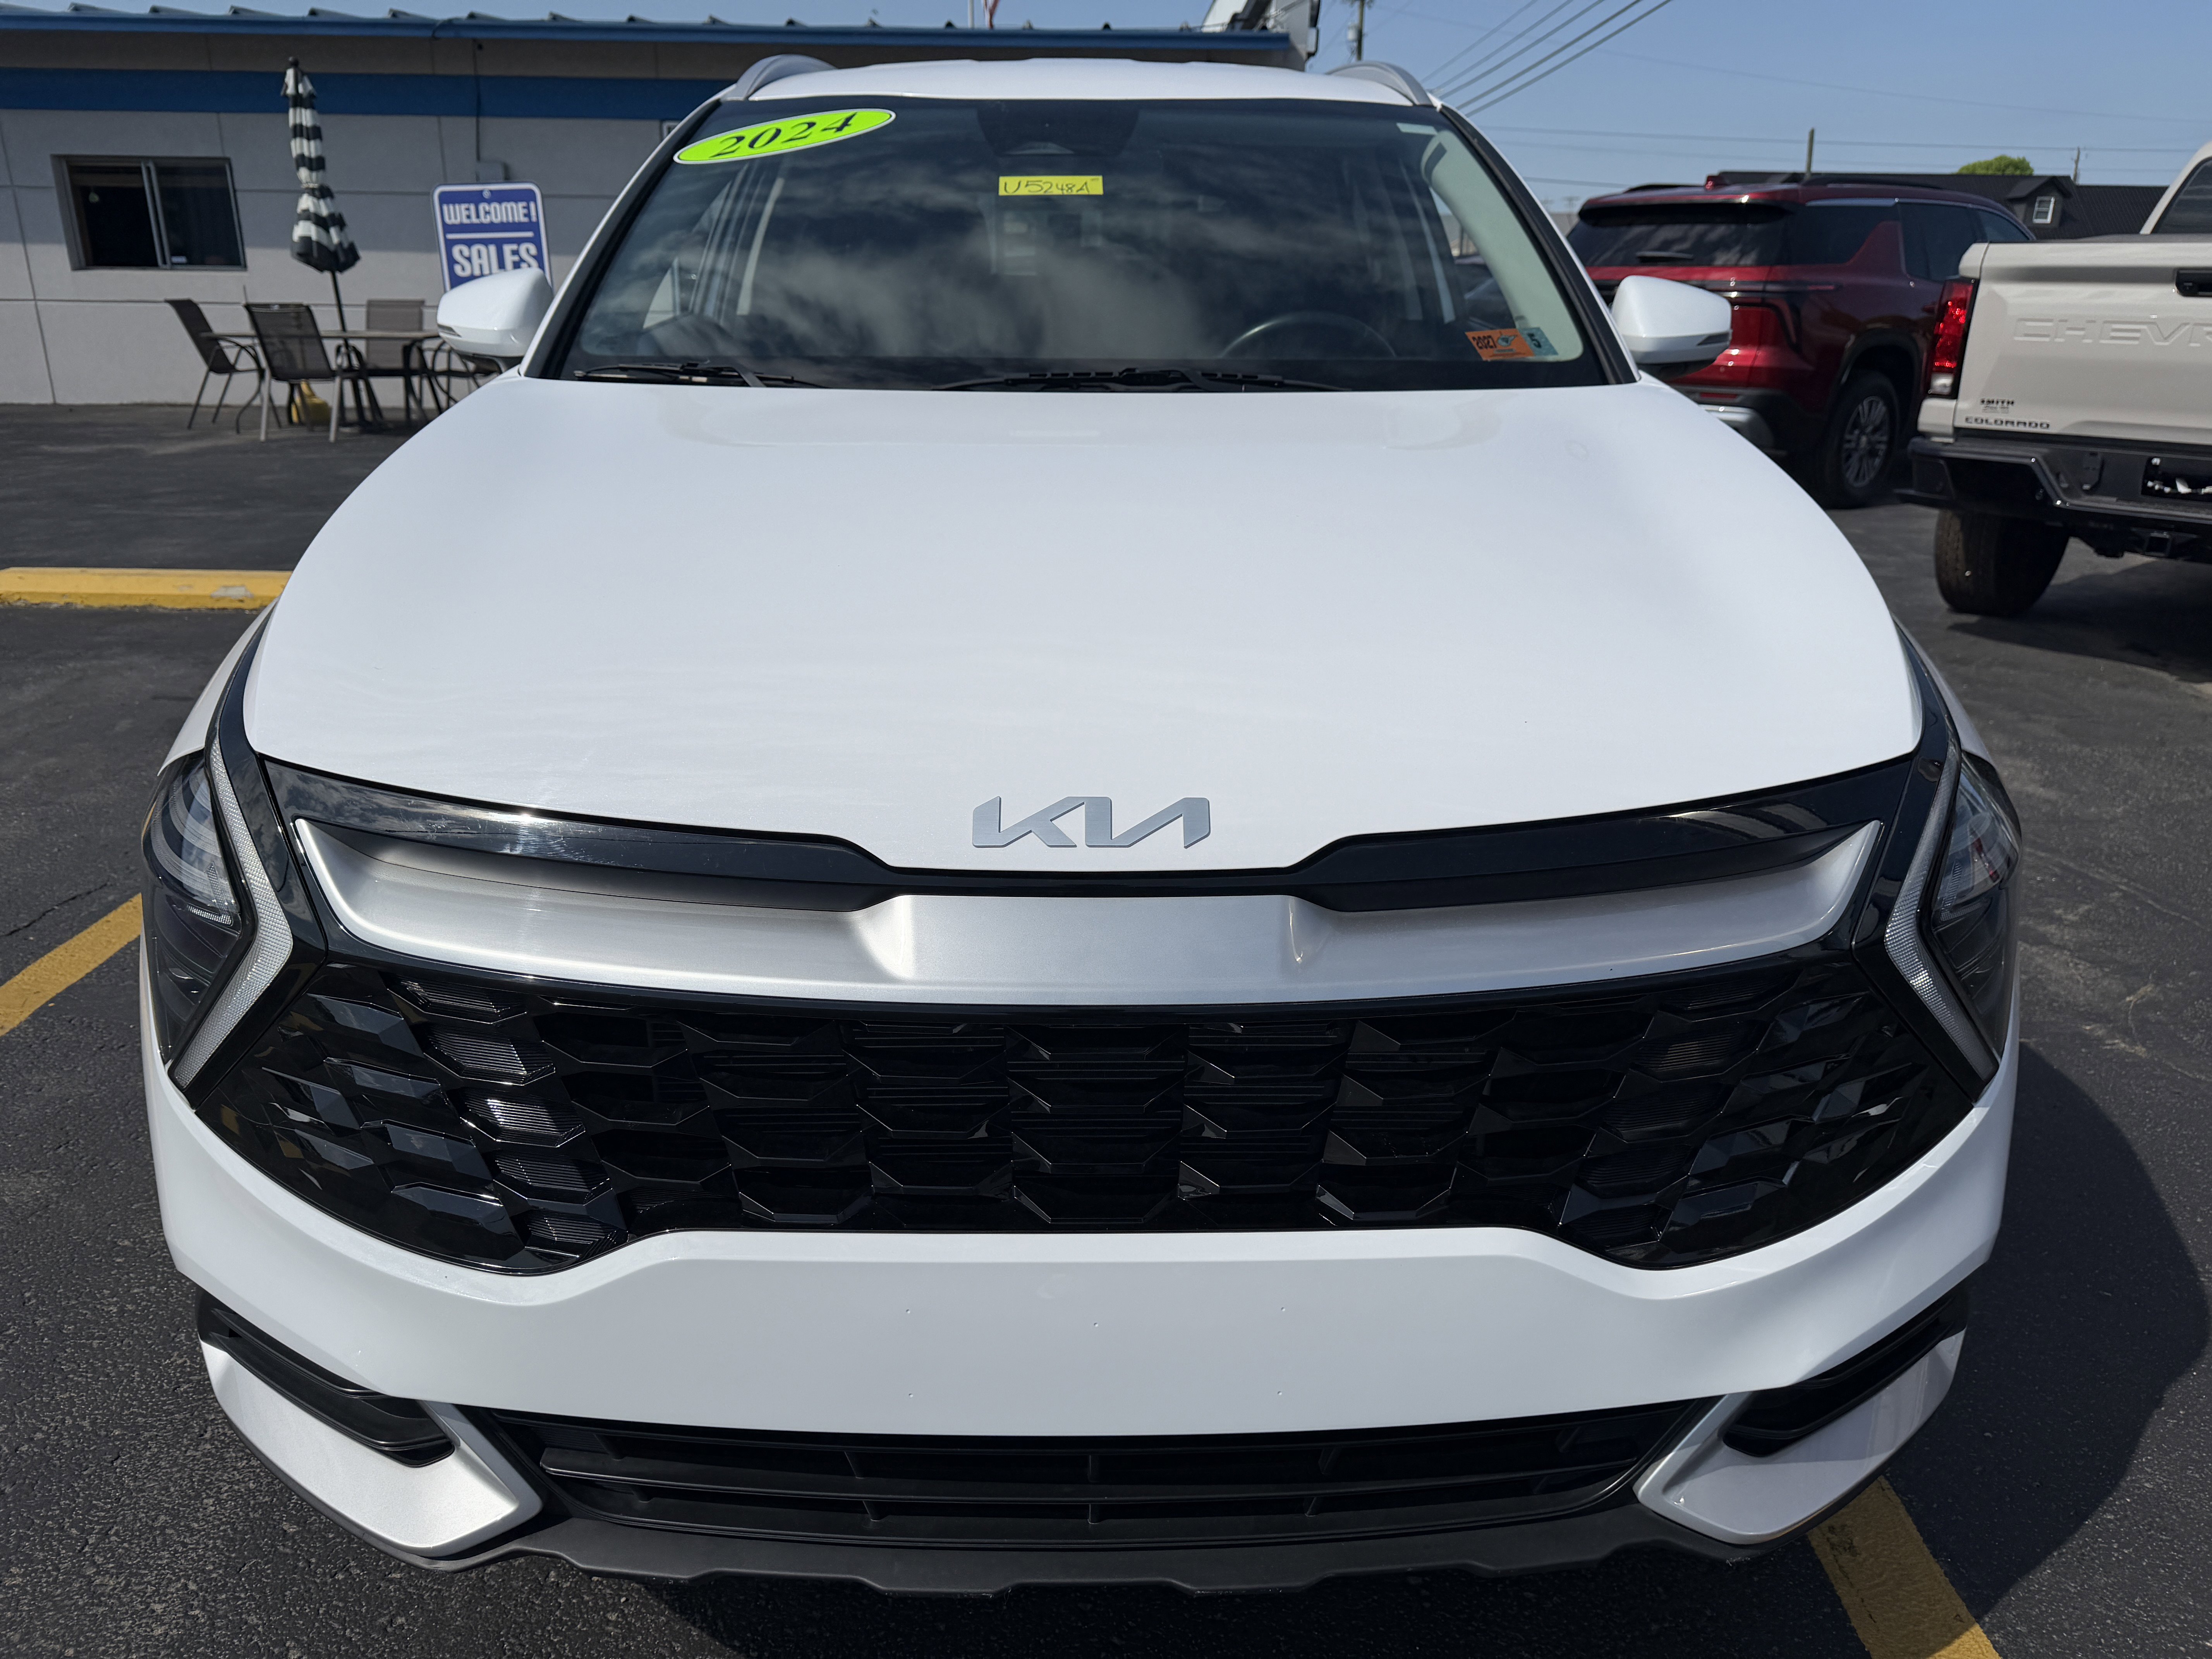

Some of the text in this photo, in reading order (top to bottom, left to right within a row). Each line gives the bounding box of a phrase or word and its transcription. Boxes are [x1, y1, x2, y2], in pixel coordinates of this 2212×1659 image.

[709, 112, 858, 158] 2024
[442, 201, 537, 225] WELCOME!
[452, 242, 540, 277] SALES
[1472, 335, 1497, 349] 2027
[1965, 416, 2050, 429] COLORADO
[972, 796, 1211, 849] KIA
